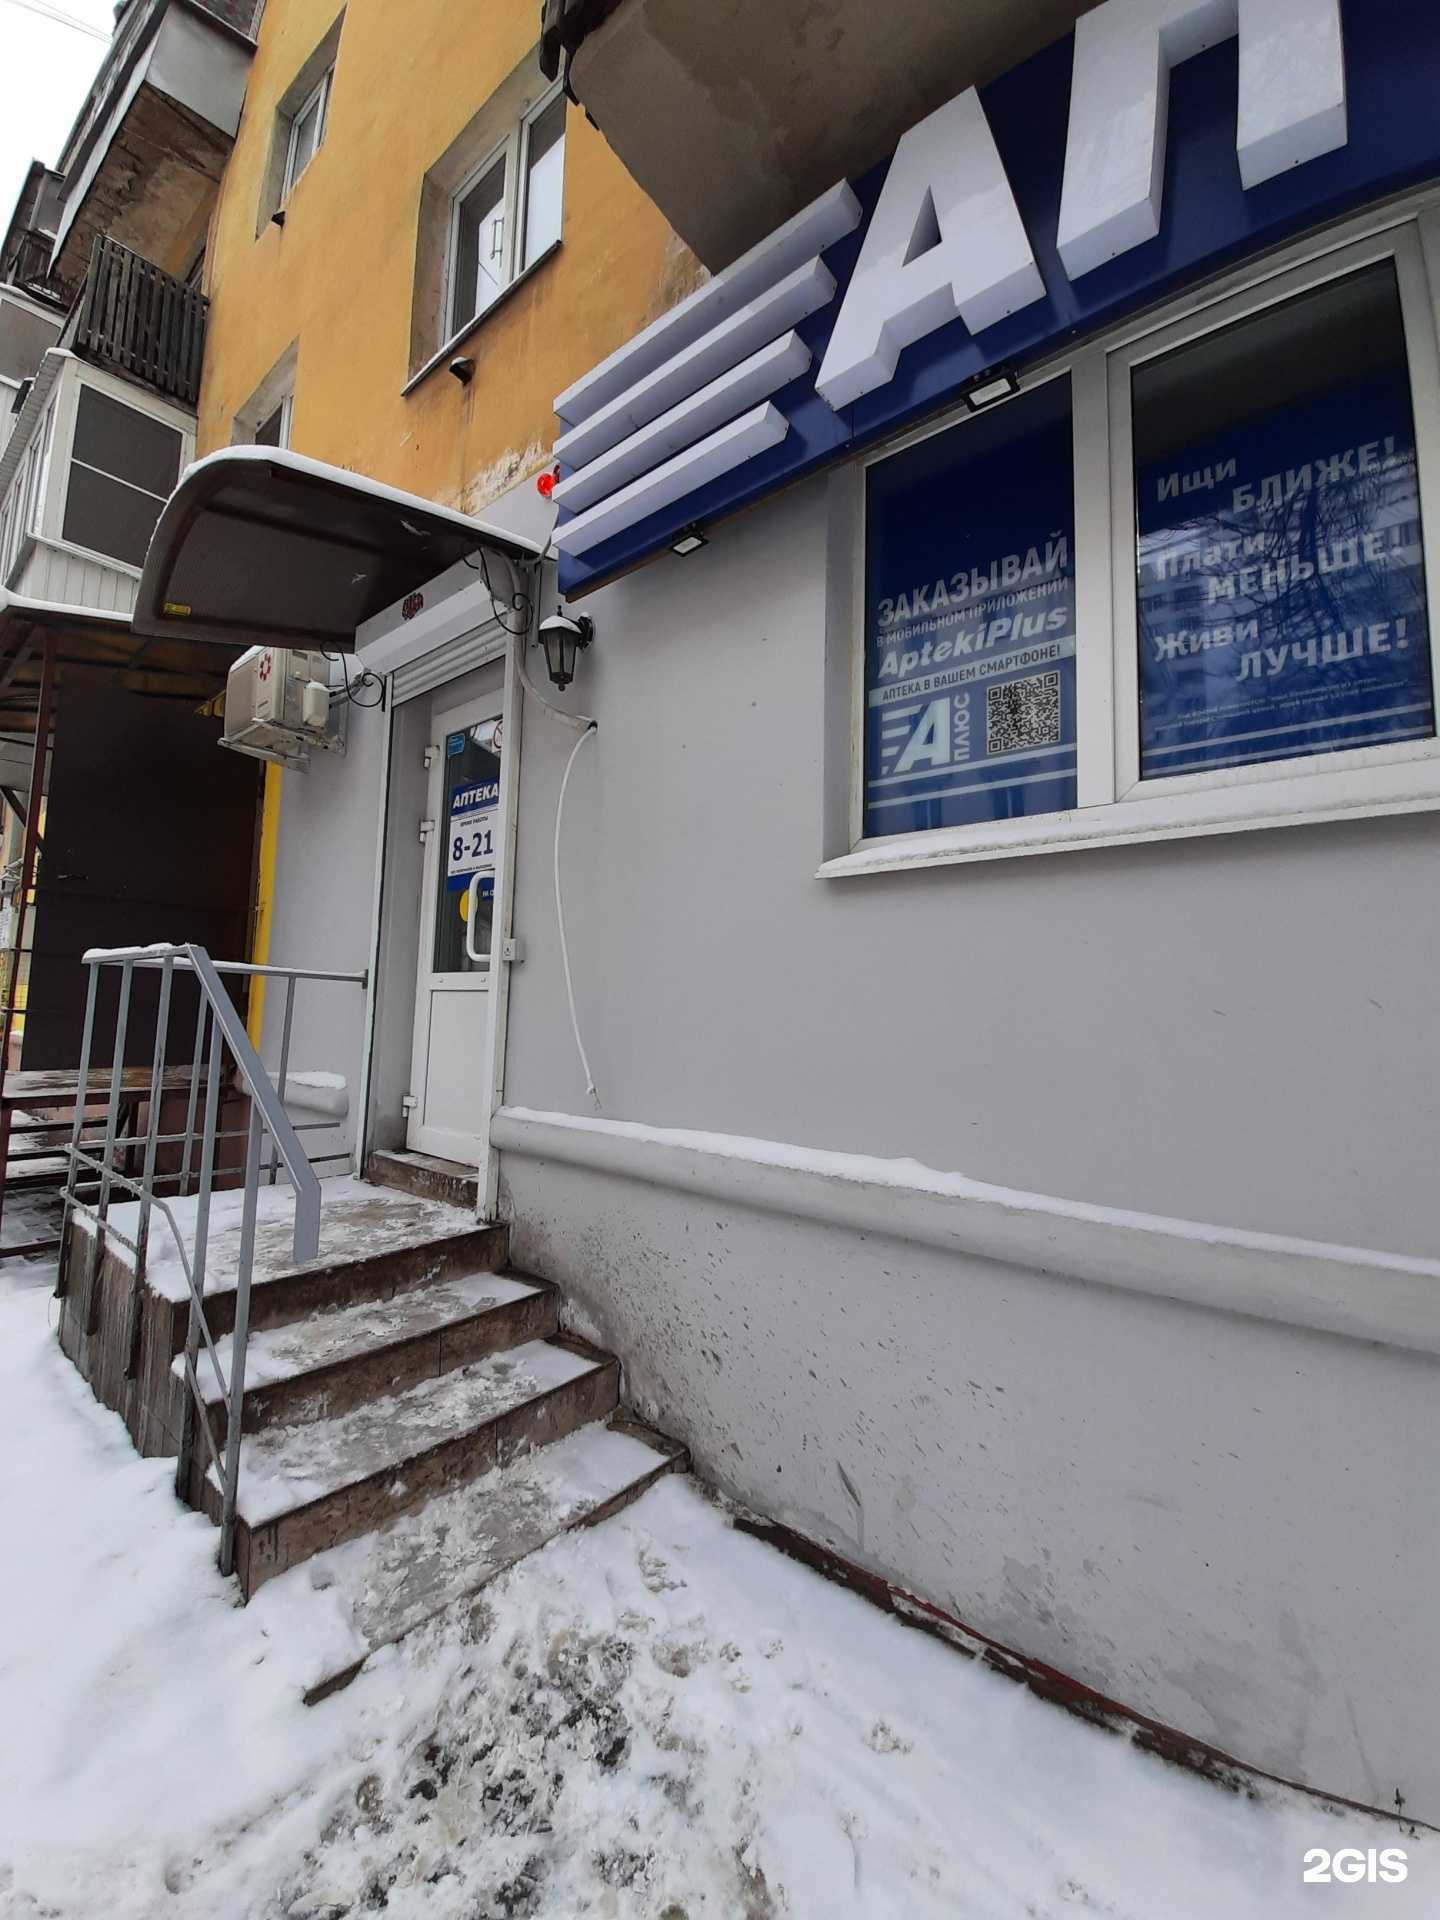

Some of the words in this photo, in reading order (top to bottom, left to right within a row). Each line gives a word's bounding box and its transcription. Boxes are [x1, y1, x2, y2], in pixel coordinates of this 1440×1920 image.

[814, 0, 1348, 412] АП
[1156, 458, 1237, 502] Ищи
[1232, 436, 1395, 514] БЛИЖЕ!
[876, 530, 1068, 628] ЗАКАЗЫВАЙ
[1155, 532, 1266, 581] Плати
[876, 635, 884, 648] В
[886, 610, 966, 644] МОБИЛЬНОМ
[967, 576, 1069, 620] ПРИЛОЖЕНИИ
[877, 606, 1068, 679] AptekiPlus
[1154, 619, 1258, 662] Живи
[882, 682, 921, 701] АПТЕКА
[924, 678, 931, 690] В
[933, 668, 976, 689] ВАШЕМ
[979, 644, 1061, 676] СМАРТФОНЕ!
[1236, 618, 1409, 682] ЛУЧШЕ!
[953, 692, 971, 761] ПЛЮС
[452, 783, 499, 809] АПТЕКА
[452, 829, 493, 861] 8-21
